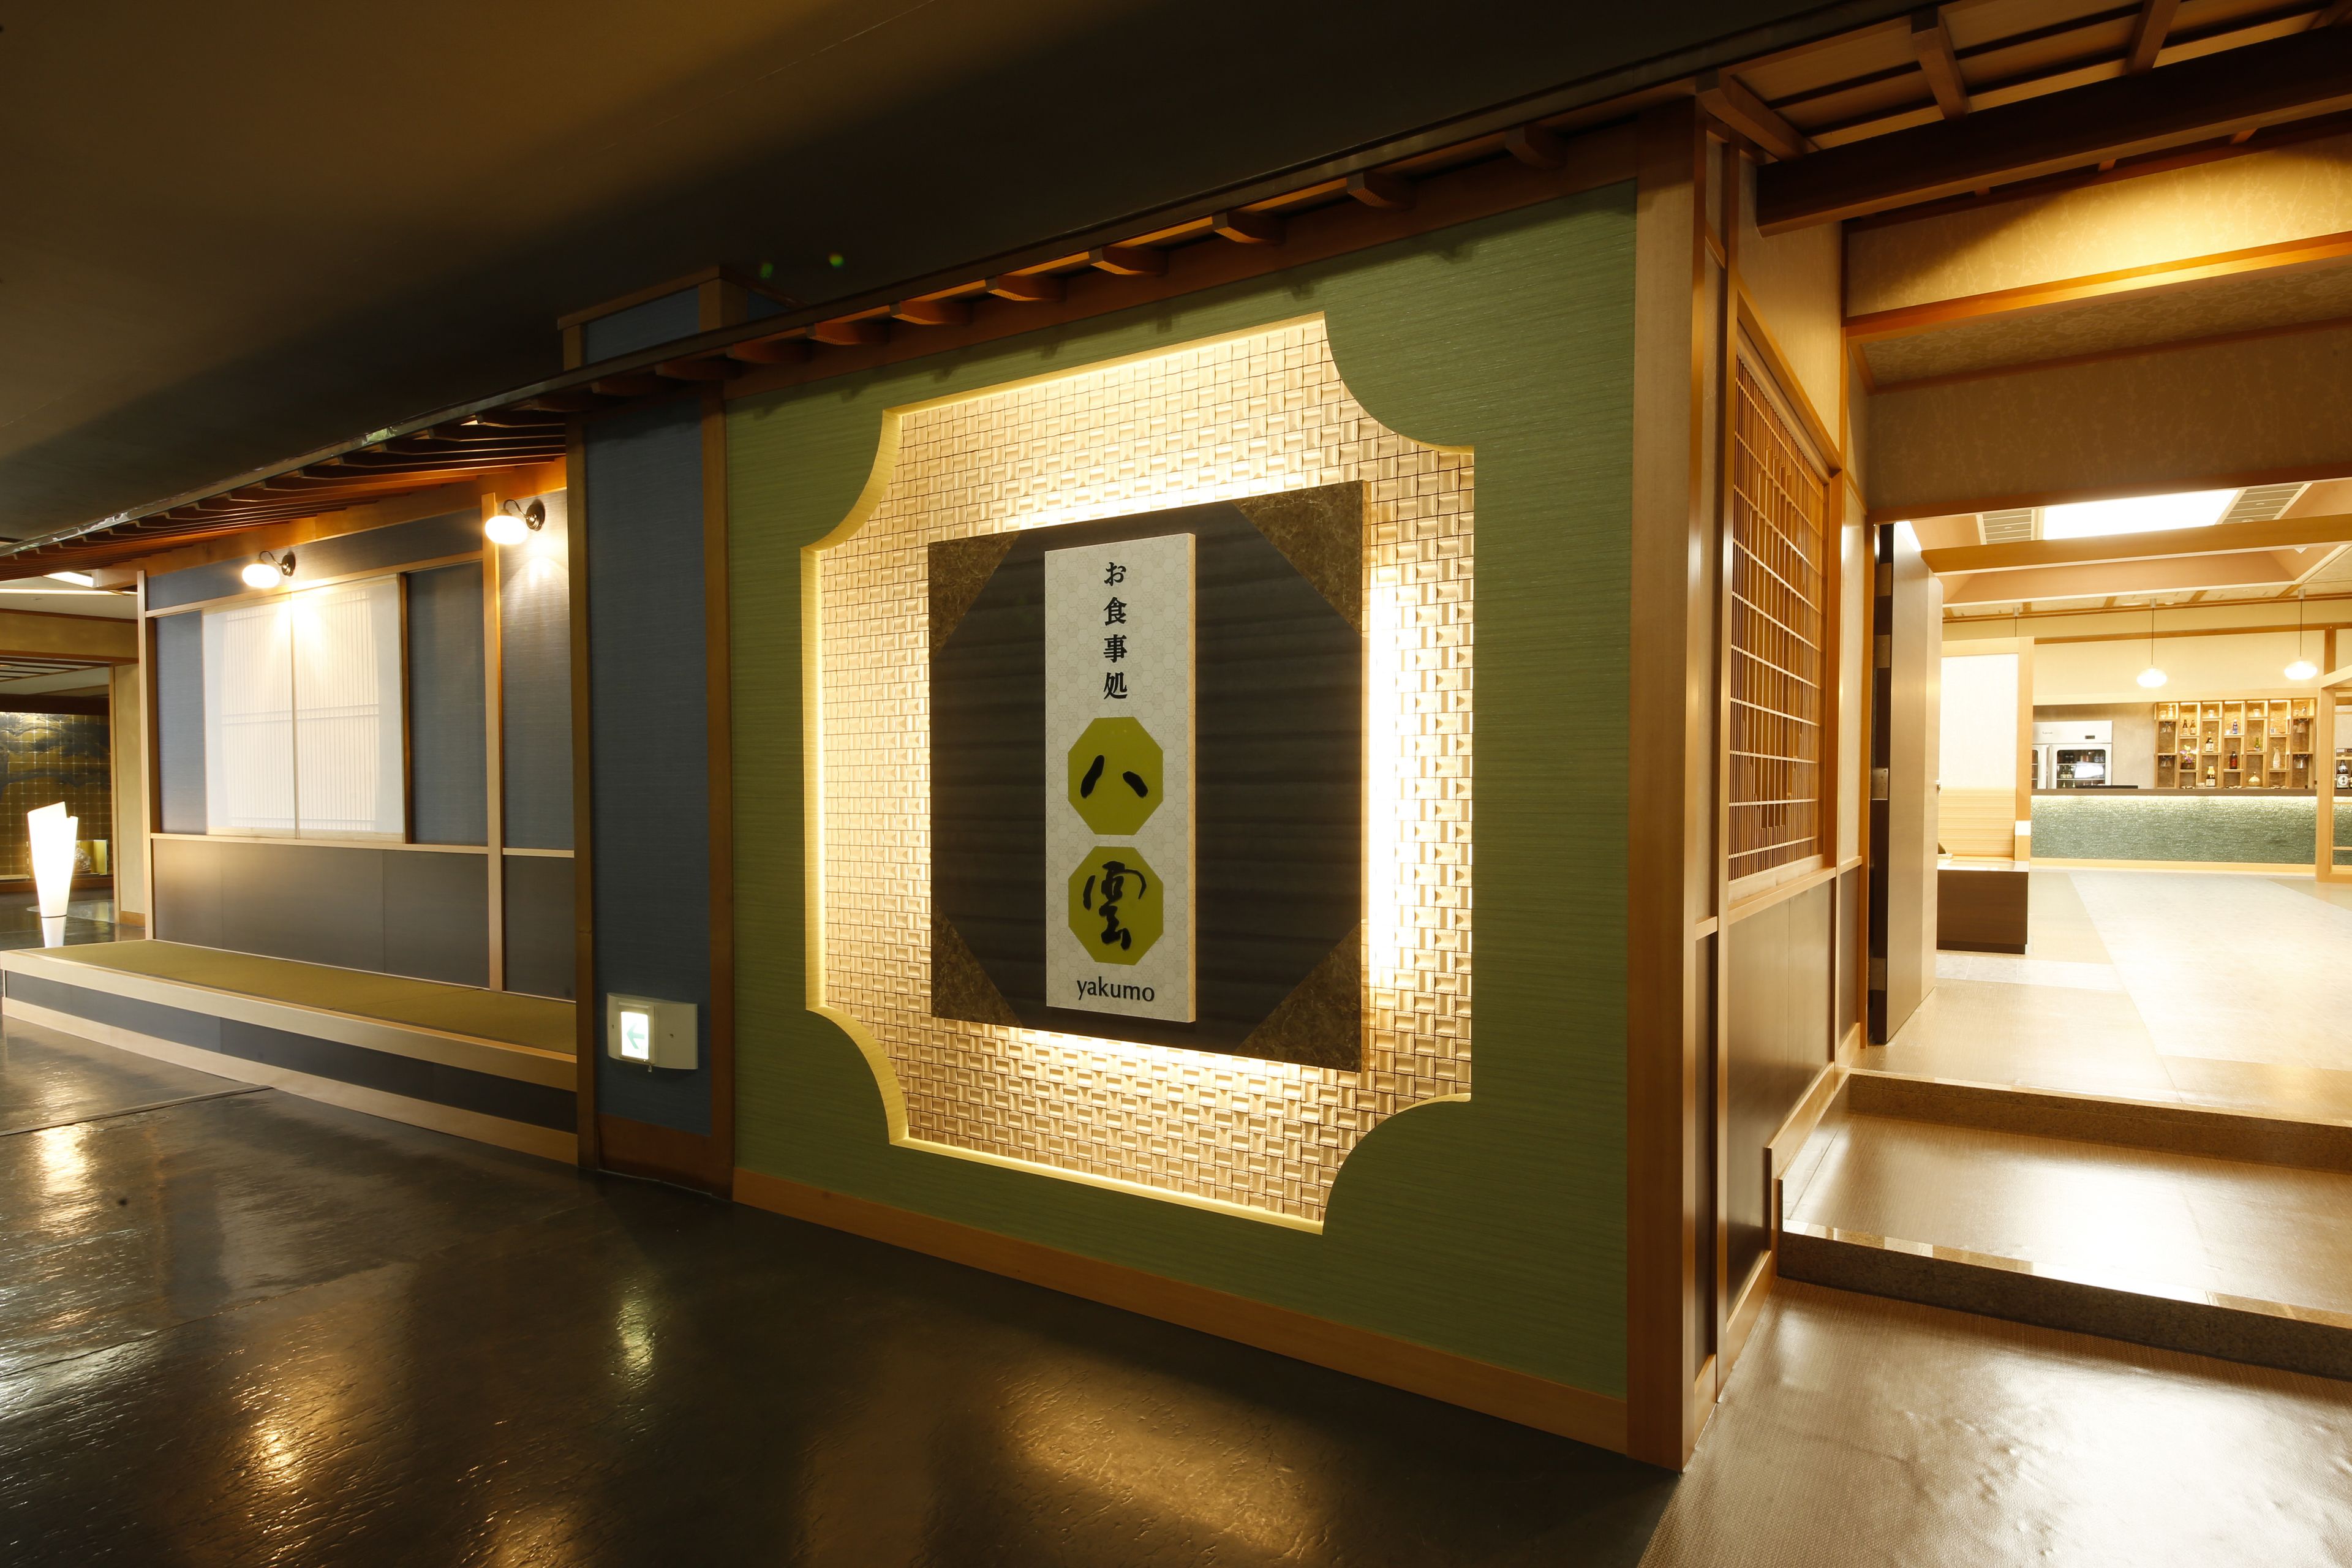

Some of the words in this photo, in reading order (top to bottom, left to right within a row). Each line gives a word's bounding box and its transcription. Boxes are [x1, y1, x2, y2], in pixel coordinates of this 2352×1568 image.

[1103, 562, 1128, 700] お食事処
[1080, 755, 1148, 951] 八雲
[1076, 976, 1155, 1002] yakumo
